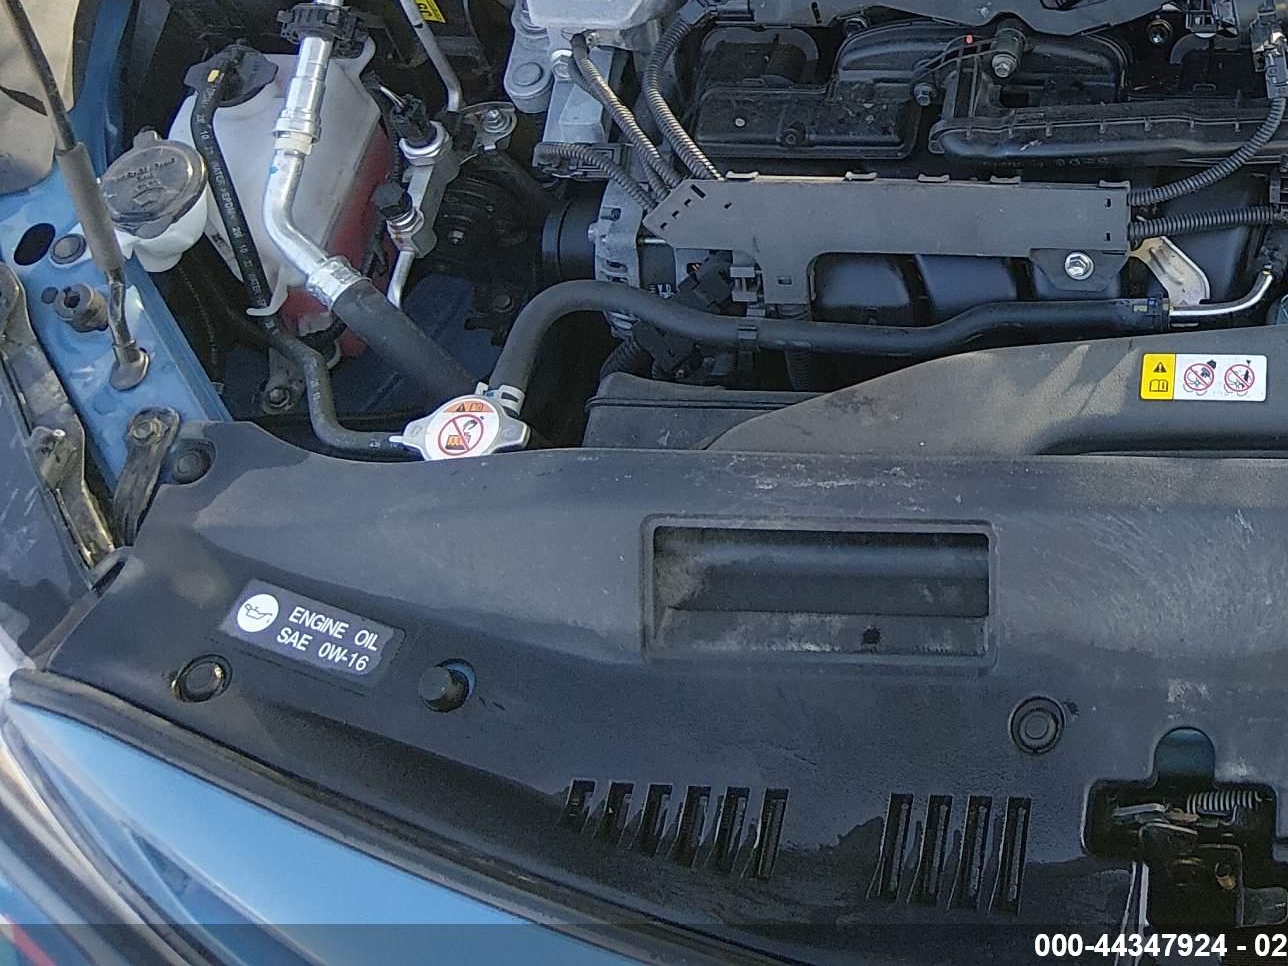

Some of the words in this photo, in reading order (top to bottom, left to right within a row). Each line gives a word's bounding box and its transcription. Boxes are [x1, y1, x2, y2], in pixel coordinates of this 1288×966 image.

[277, 627, 312, 650] SAE
[318, 642, 369, 670] 0W-16
[289, 607, 348, 638] ENGINE
[354, 630, 378, 650] OIL
